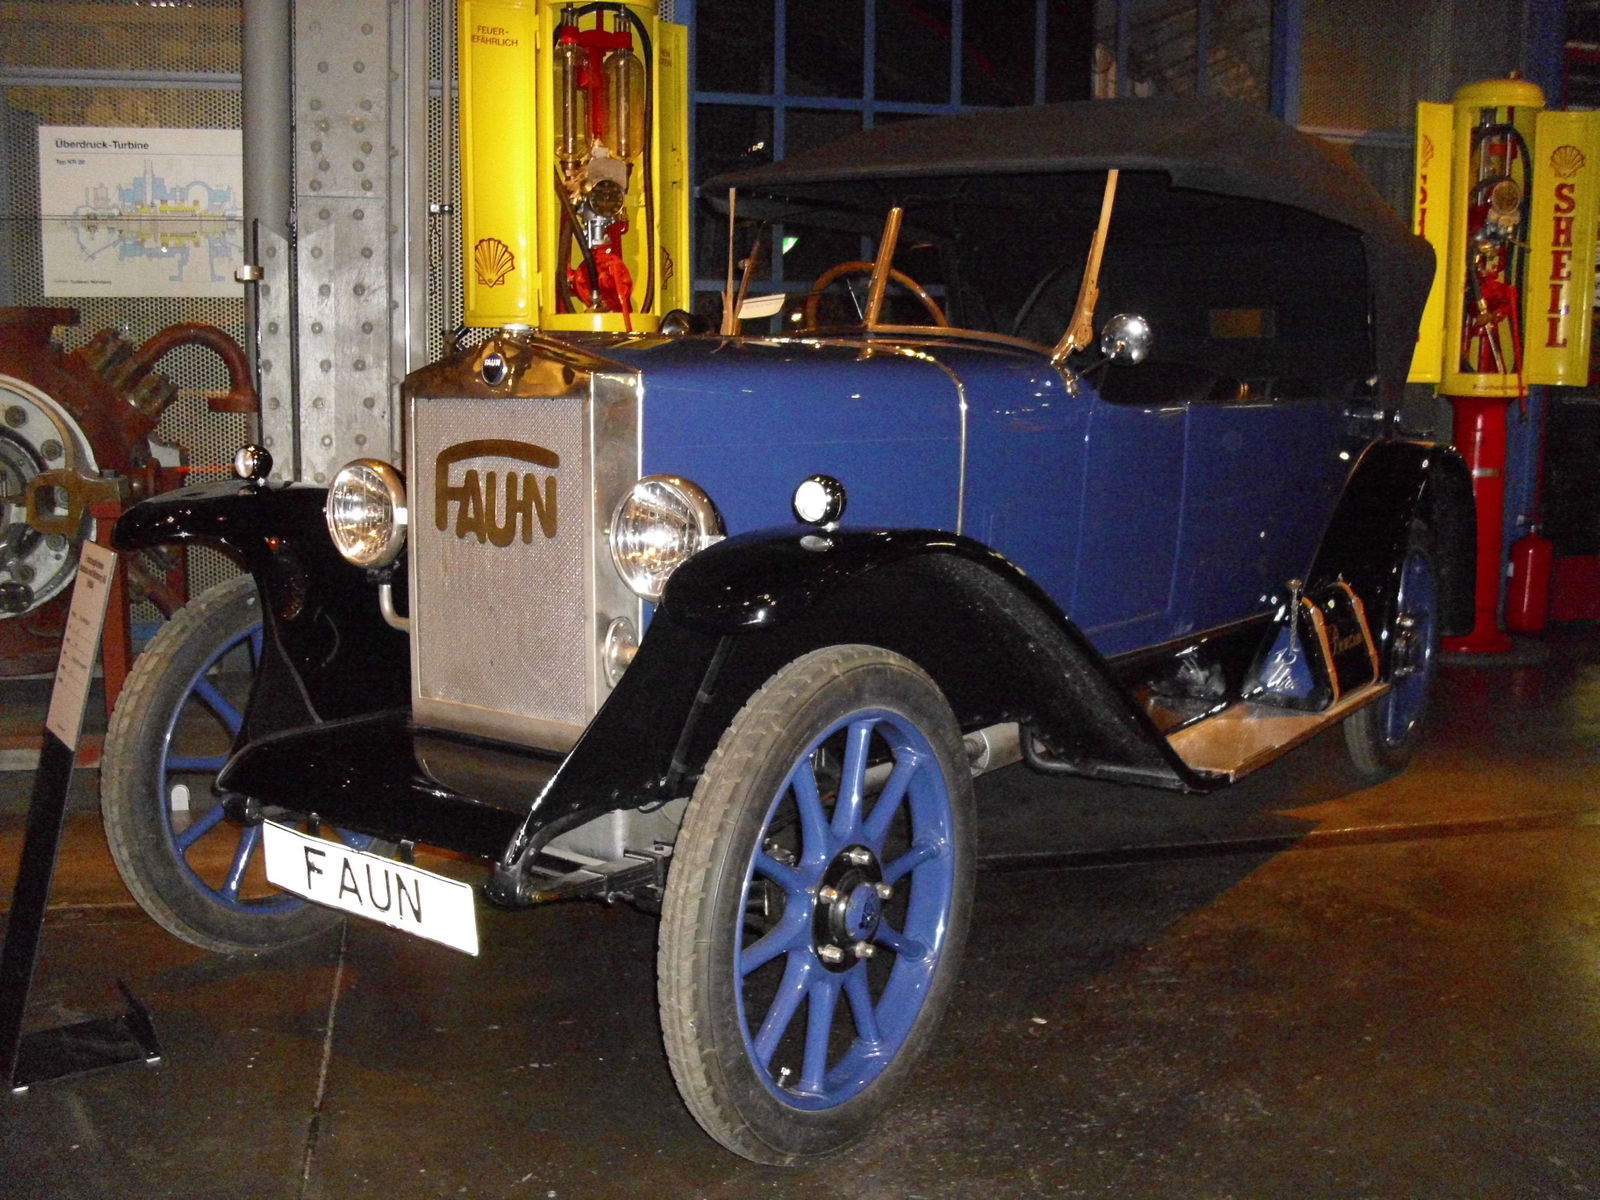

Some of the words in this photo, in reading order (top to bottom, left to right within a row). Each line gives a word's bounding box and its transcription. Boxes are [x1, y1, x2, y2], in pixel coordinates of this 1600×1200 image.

[55, 137, 150, 150] Überdruck-Turbine
[1545, 183, 1577, 349] SHELL
[484, 358, 501, 367] FAUN
[435, 438, 560, 548] FAUN
[303, 845, 422, 924] FAUN
